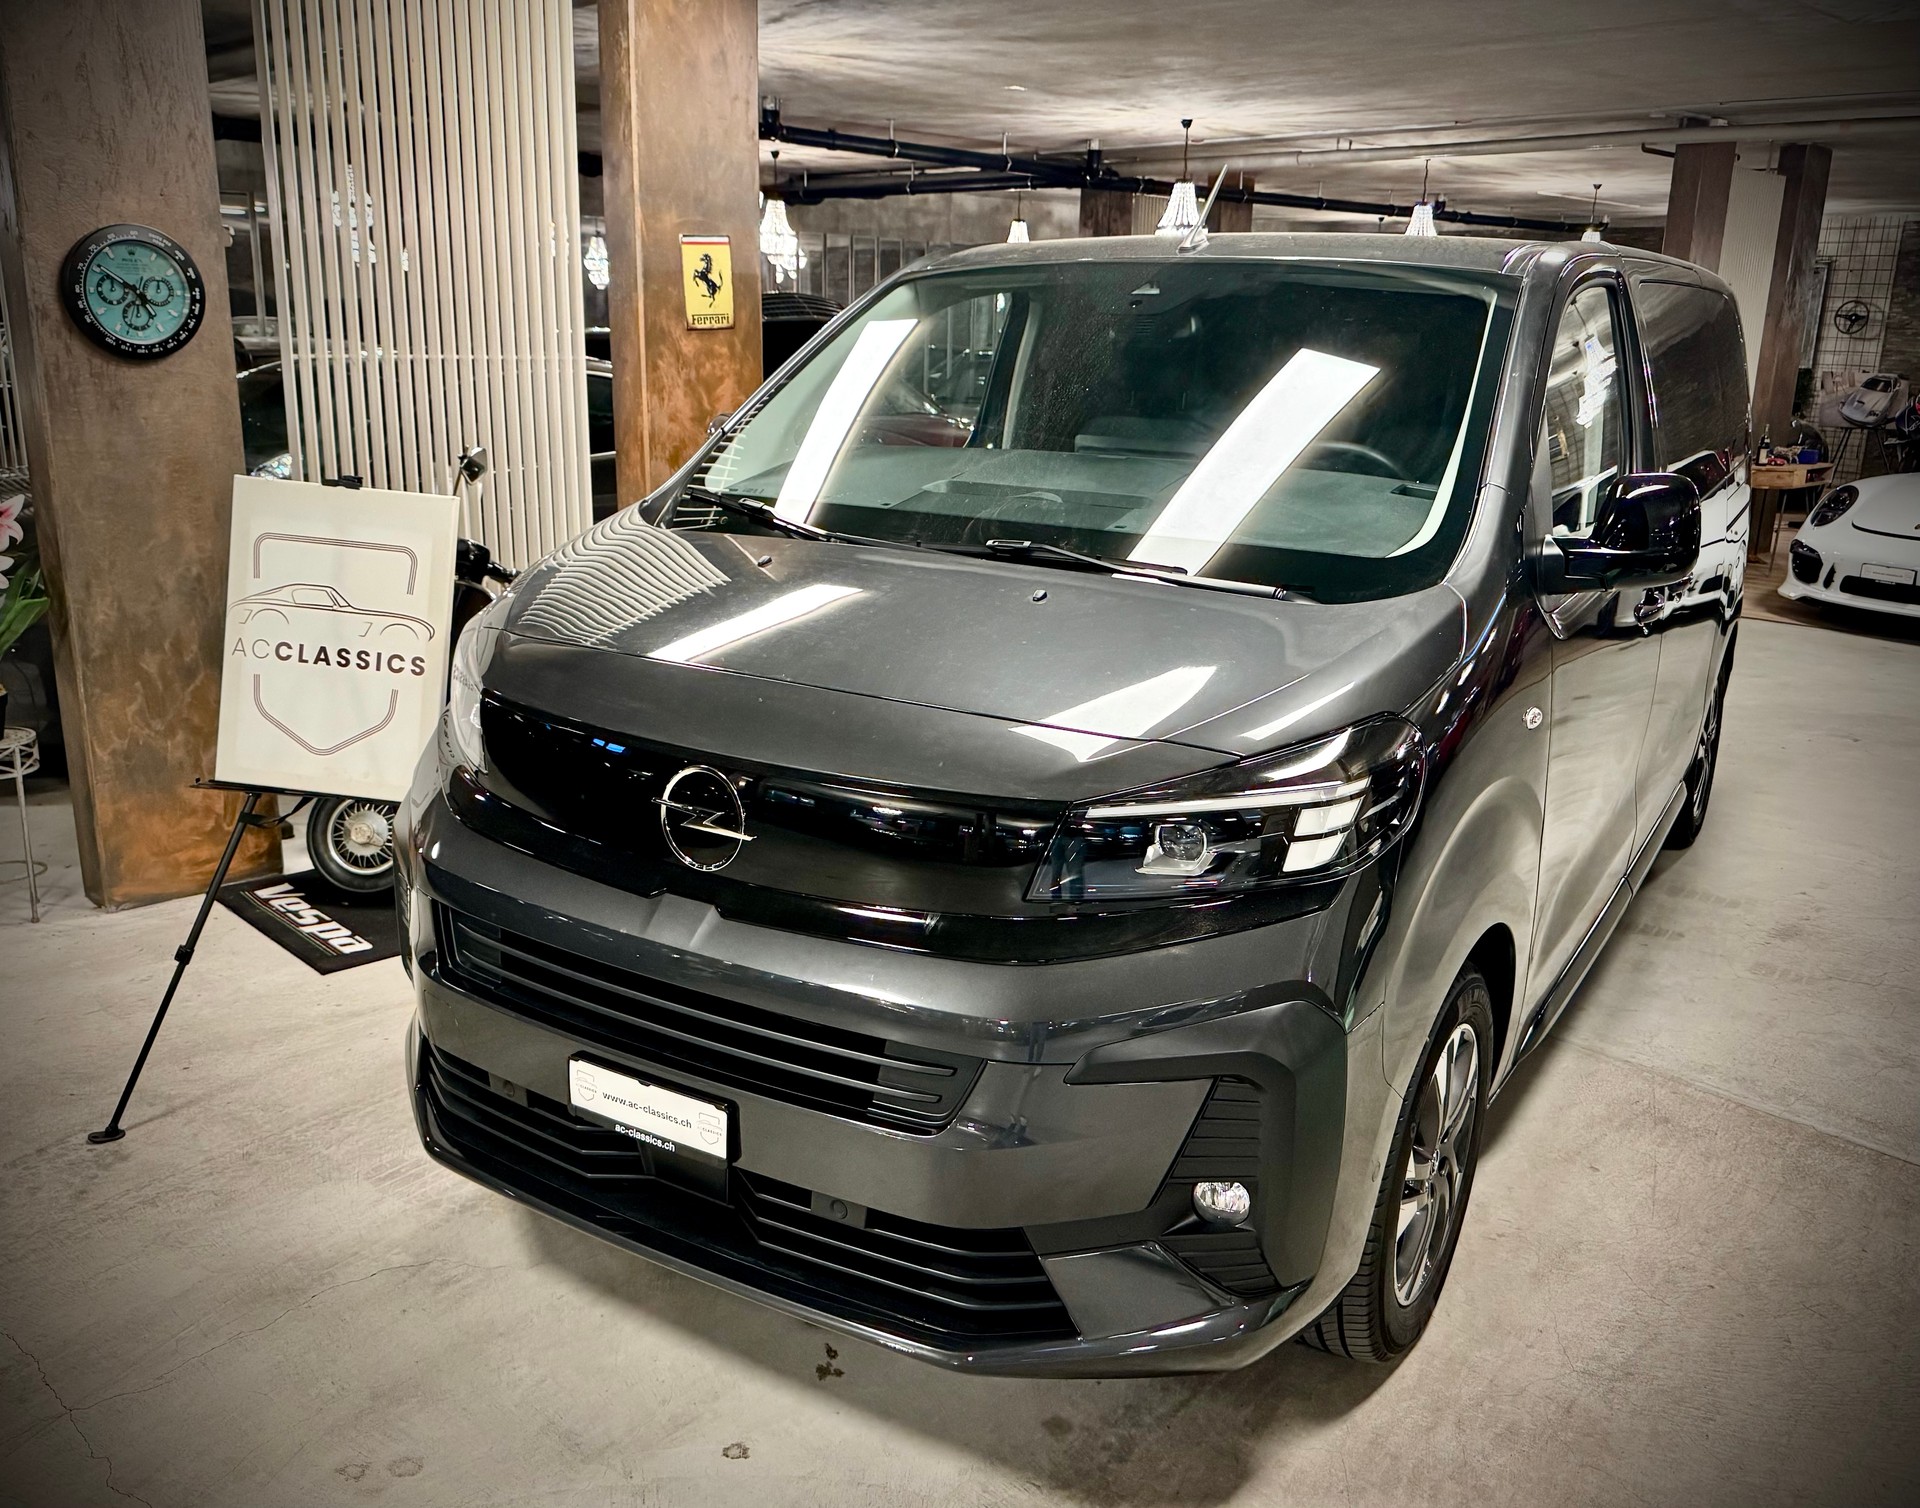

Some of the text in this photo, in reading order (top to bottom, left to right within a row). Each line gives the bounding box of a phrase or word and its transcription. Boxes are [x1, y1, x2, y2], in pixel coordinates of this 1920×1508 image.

[691, 313, 730, 325] Ferrari
[253, 882, 374, 955] Vespa
[602, 1091, 693, 1129] www.ac-classics.ch
[614, 1122, 676, 1152] ac-classics.ch
